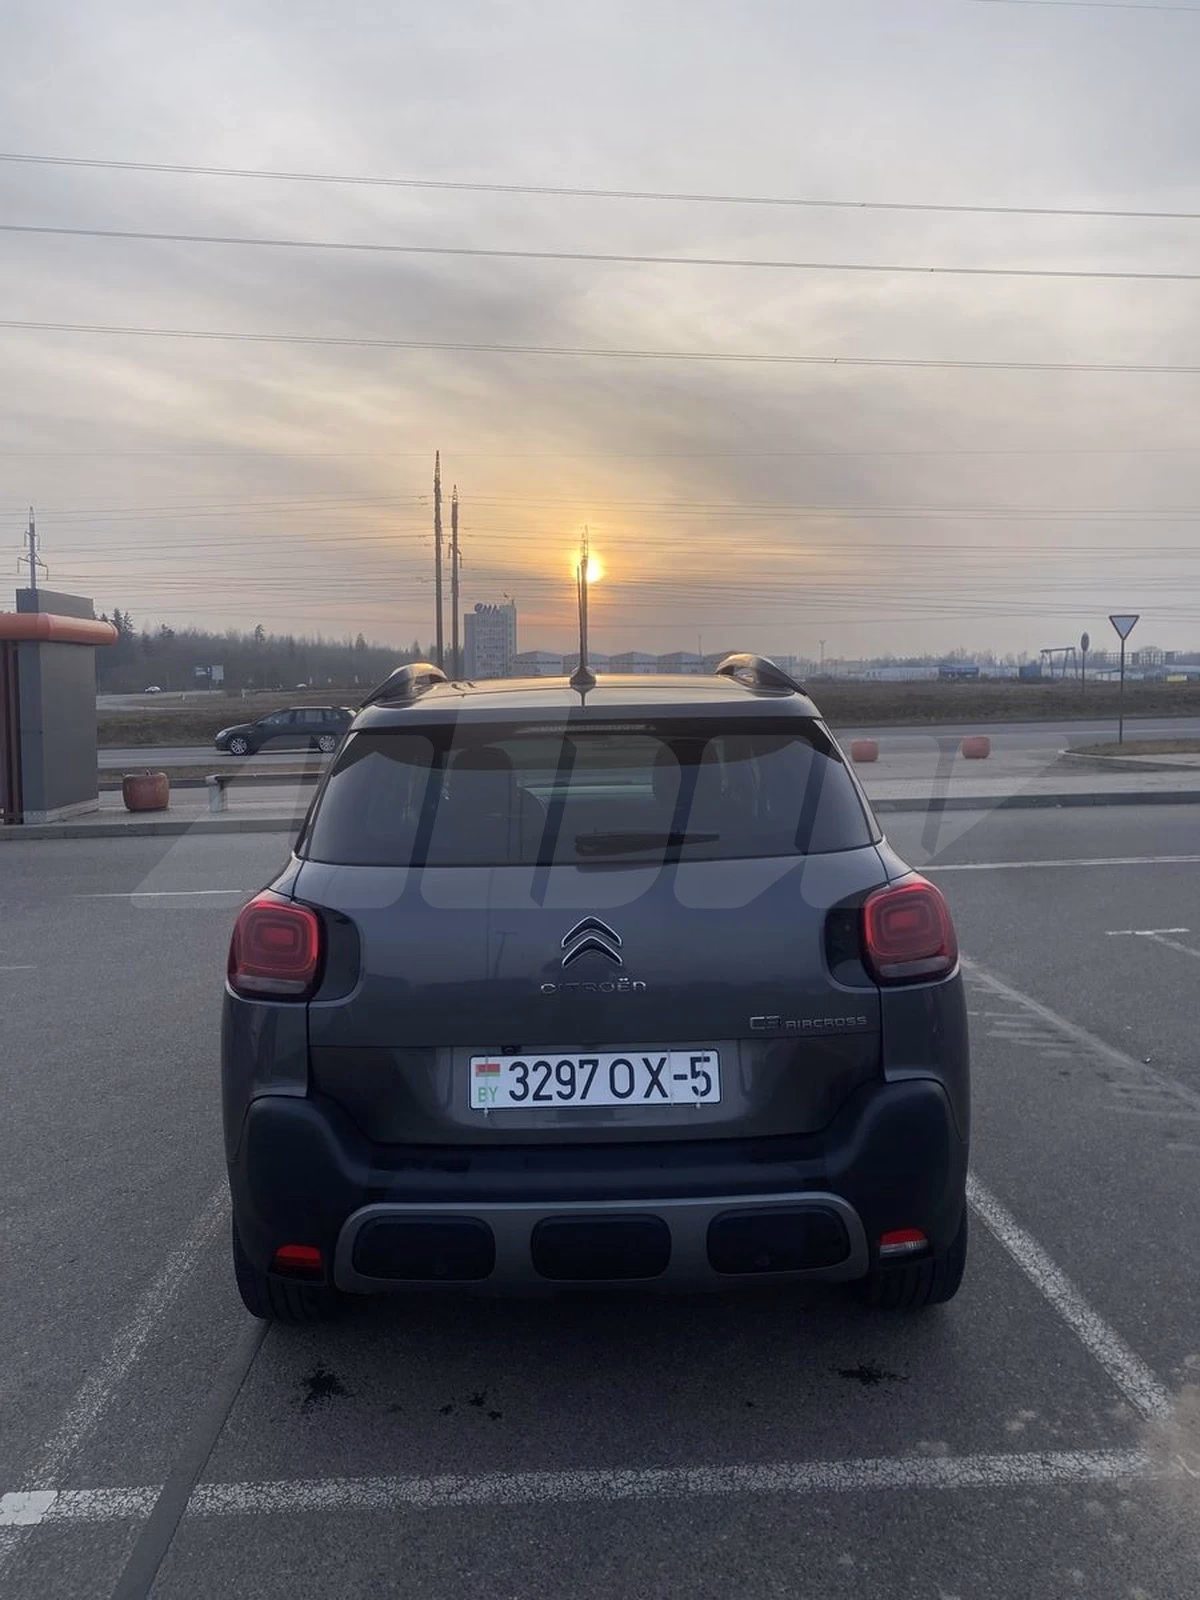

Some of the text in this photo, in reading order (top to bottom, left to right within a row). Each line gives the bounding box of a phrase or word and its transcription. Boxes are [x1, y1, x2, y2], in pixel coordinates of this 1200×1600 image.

[540, 977, 646, 994] CITROËN
[749, 1015, 867, 1030] C3 AIRCROSS
[508, 1058, 600, 1101] 3297
[477, 1086, 499, 1103] BY
